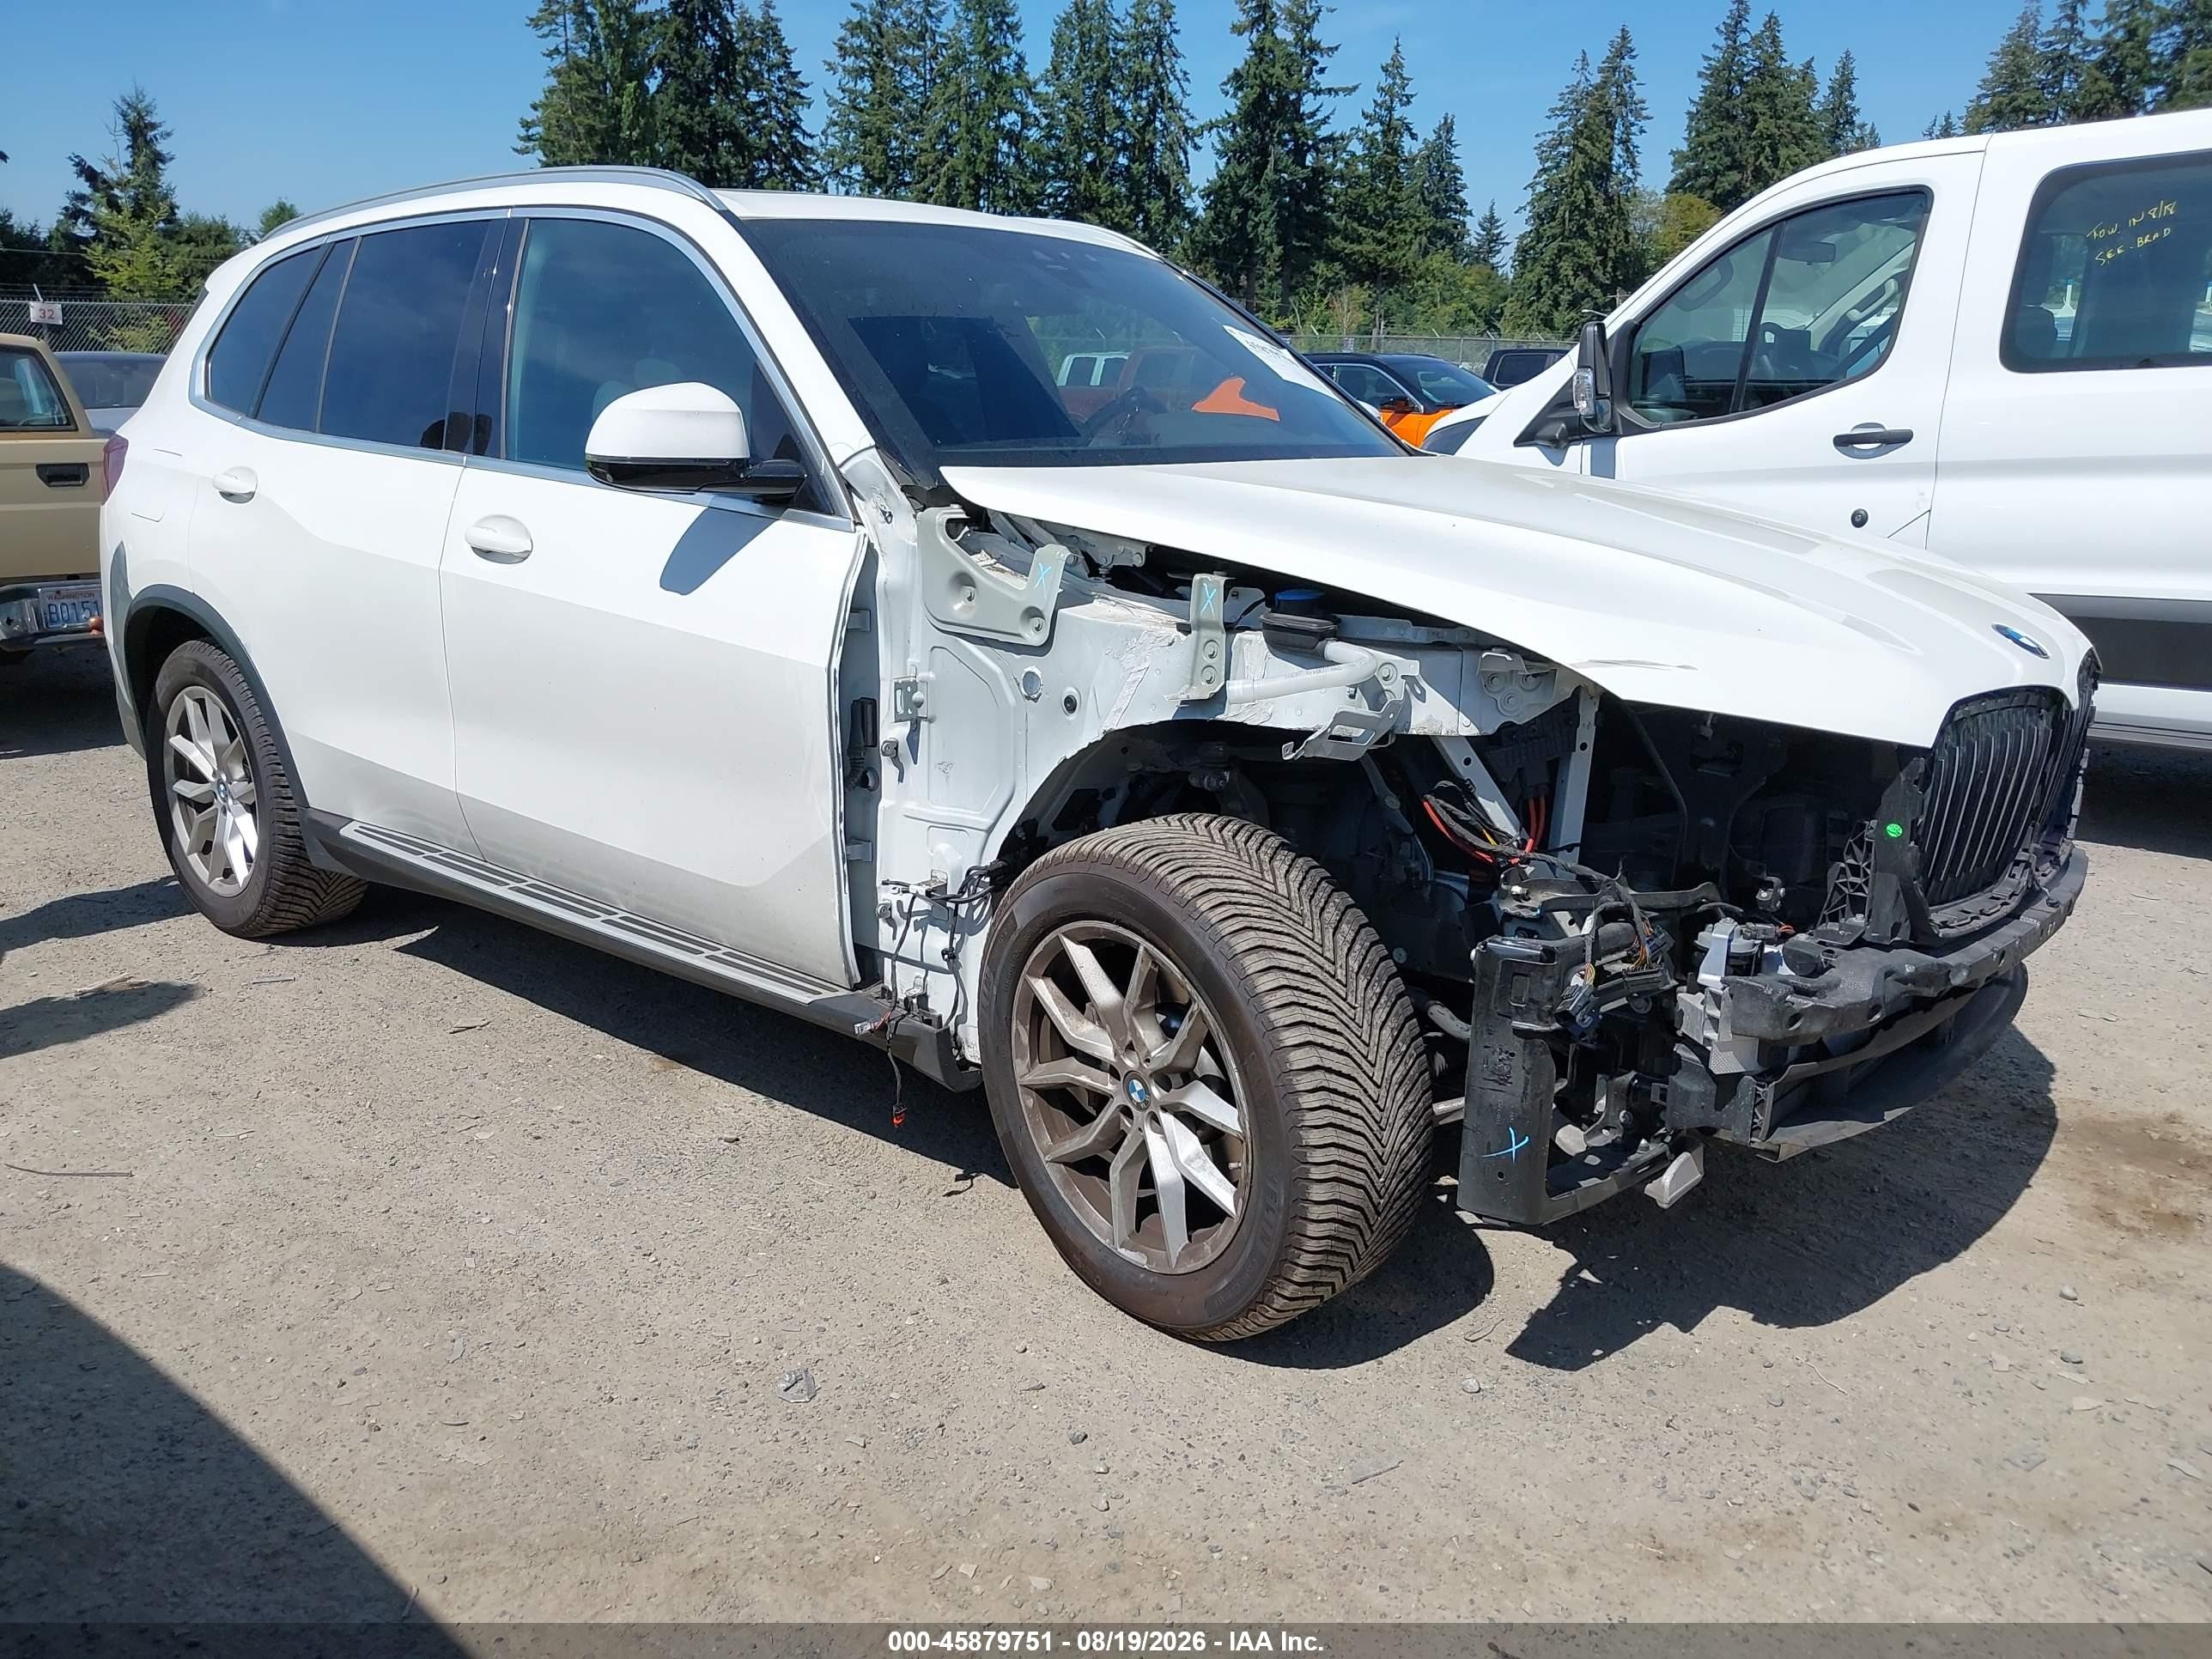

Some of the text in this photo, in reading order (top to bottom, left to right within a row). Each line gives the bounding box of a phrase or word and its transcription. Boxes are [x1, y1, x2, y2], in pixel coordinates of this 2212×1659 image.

[2095, 245, 2124, 266] SEE
[2137, 228, 2171, 248] BRAD
[40, 308, 55, 320] 32
